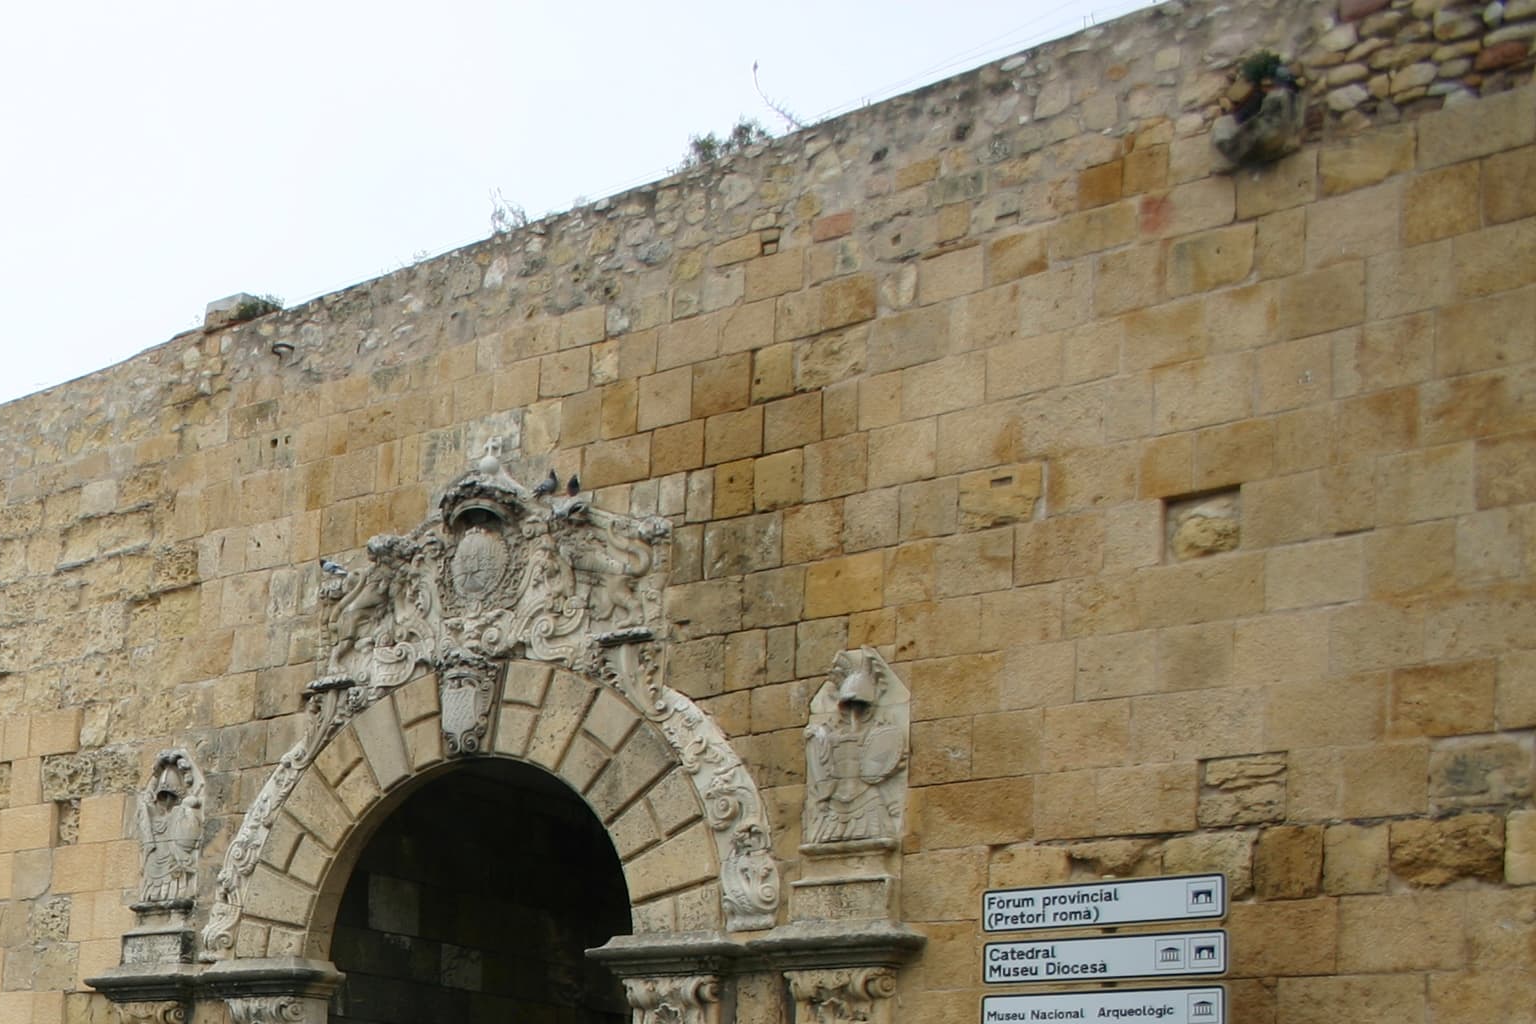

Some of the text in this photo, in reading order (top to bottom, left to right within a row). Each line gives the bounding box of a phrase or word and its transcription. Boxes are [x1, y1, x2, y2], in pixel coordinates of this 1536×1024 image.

[987, 887, 1119, 911] Fòrum provincial
[987, 906, 1100, 929] (Pretori romà)
[989, 945, 1056, 962] Catedral
[989, 960, 1107, 978] Museu Diocesà
[987, 1004, 1174, 1022] Museu Nacional Arqueològic
